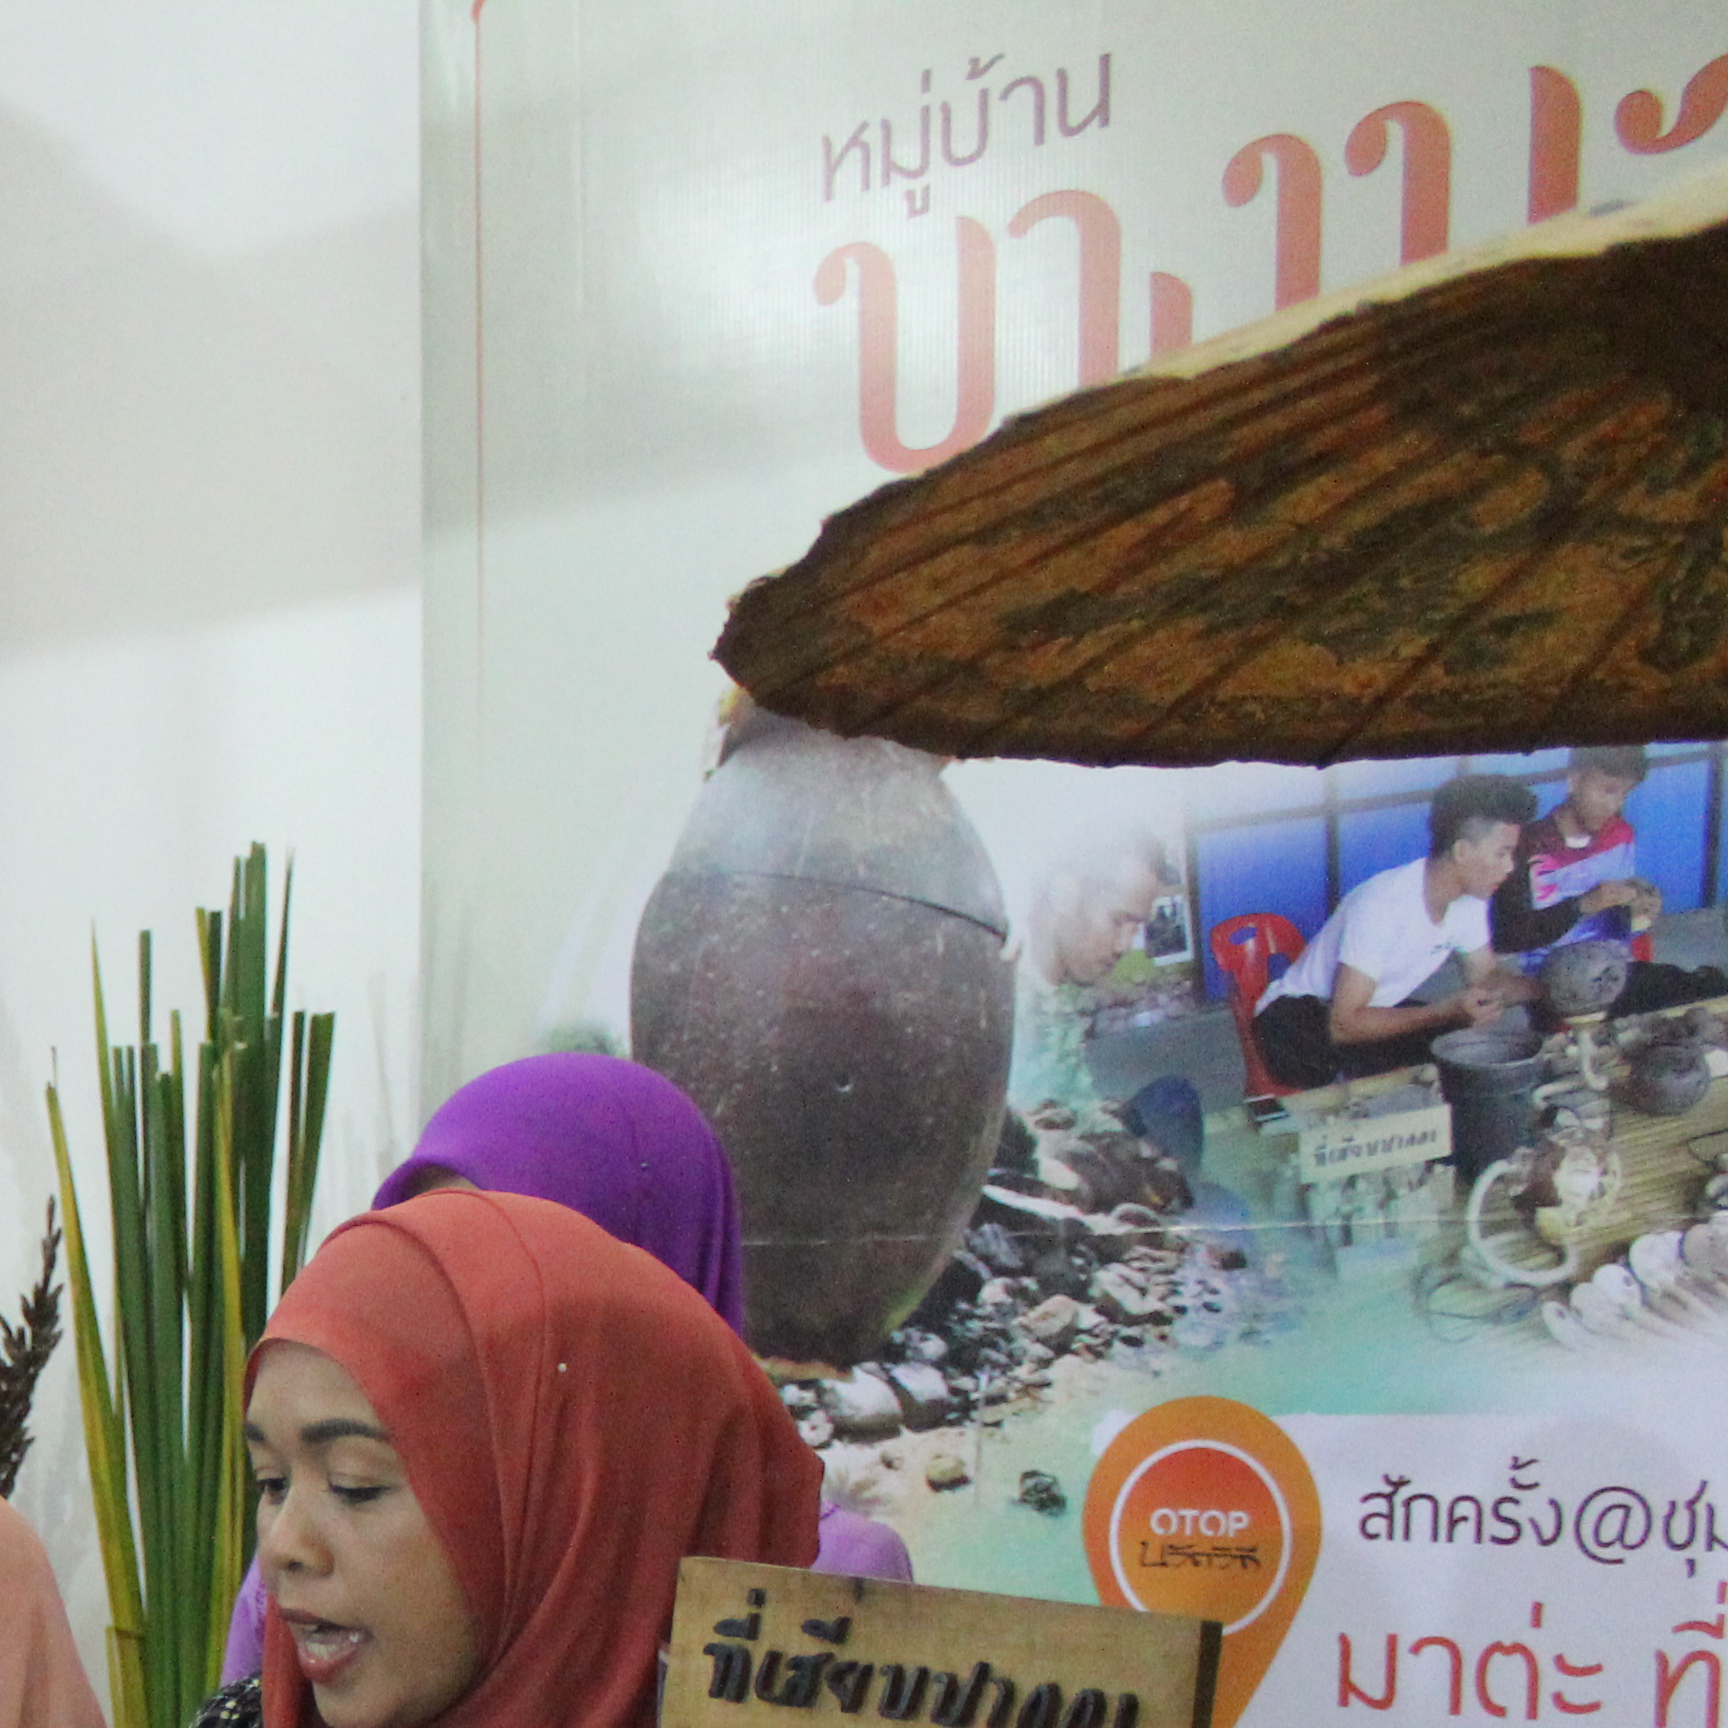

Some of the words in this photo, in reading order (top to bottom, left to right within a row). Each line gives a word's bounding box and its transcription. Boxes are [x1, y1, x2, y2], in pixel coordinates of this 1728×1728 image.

[821, 52, 1113, 218] หมู่บ้าน
[1149, 1507, 1251, 1538] OTOP
[1337, 1602, 1604, 1721] มาต่ะ
